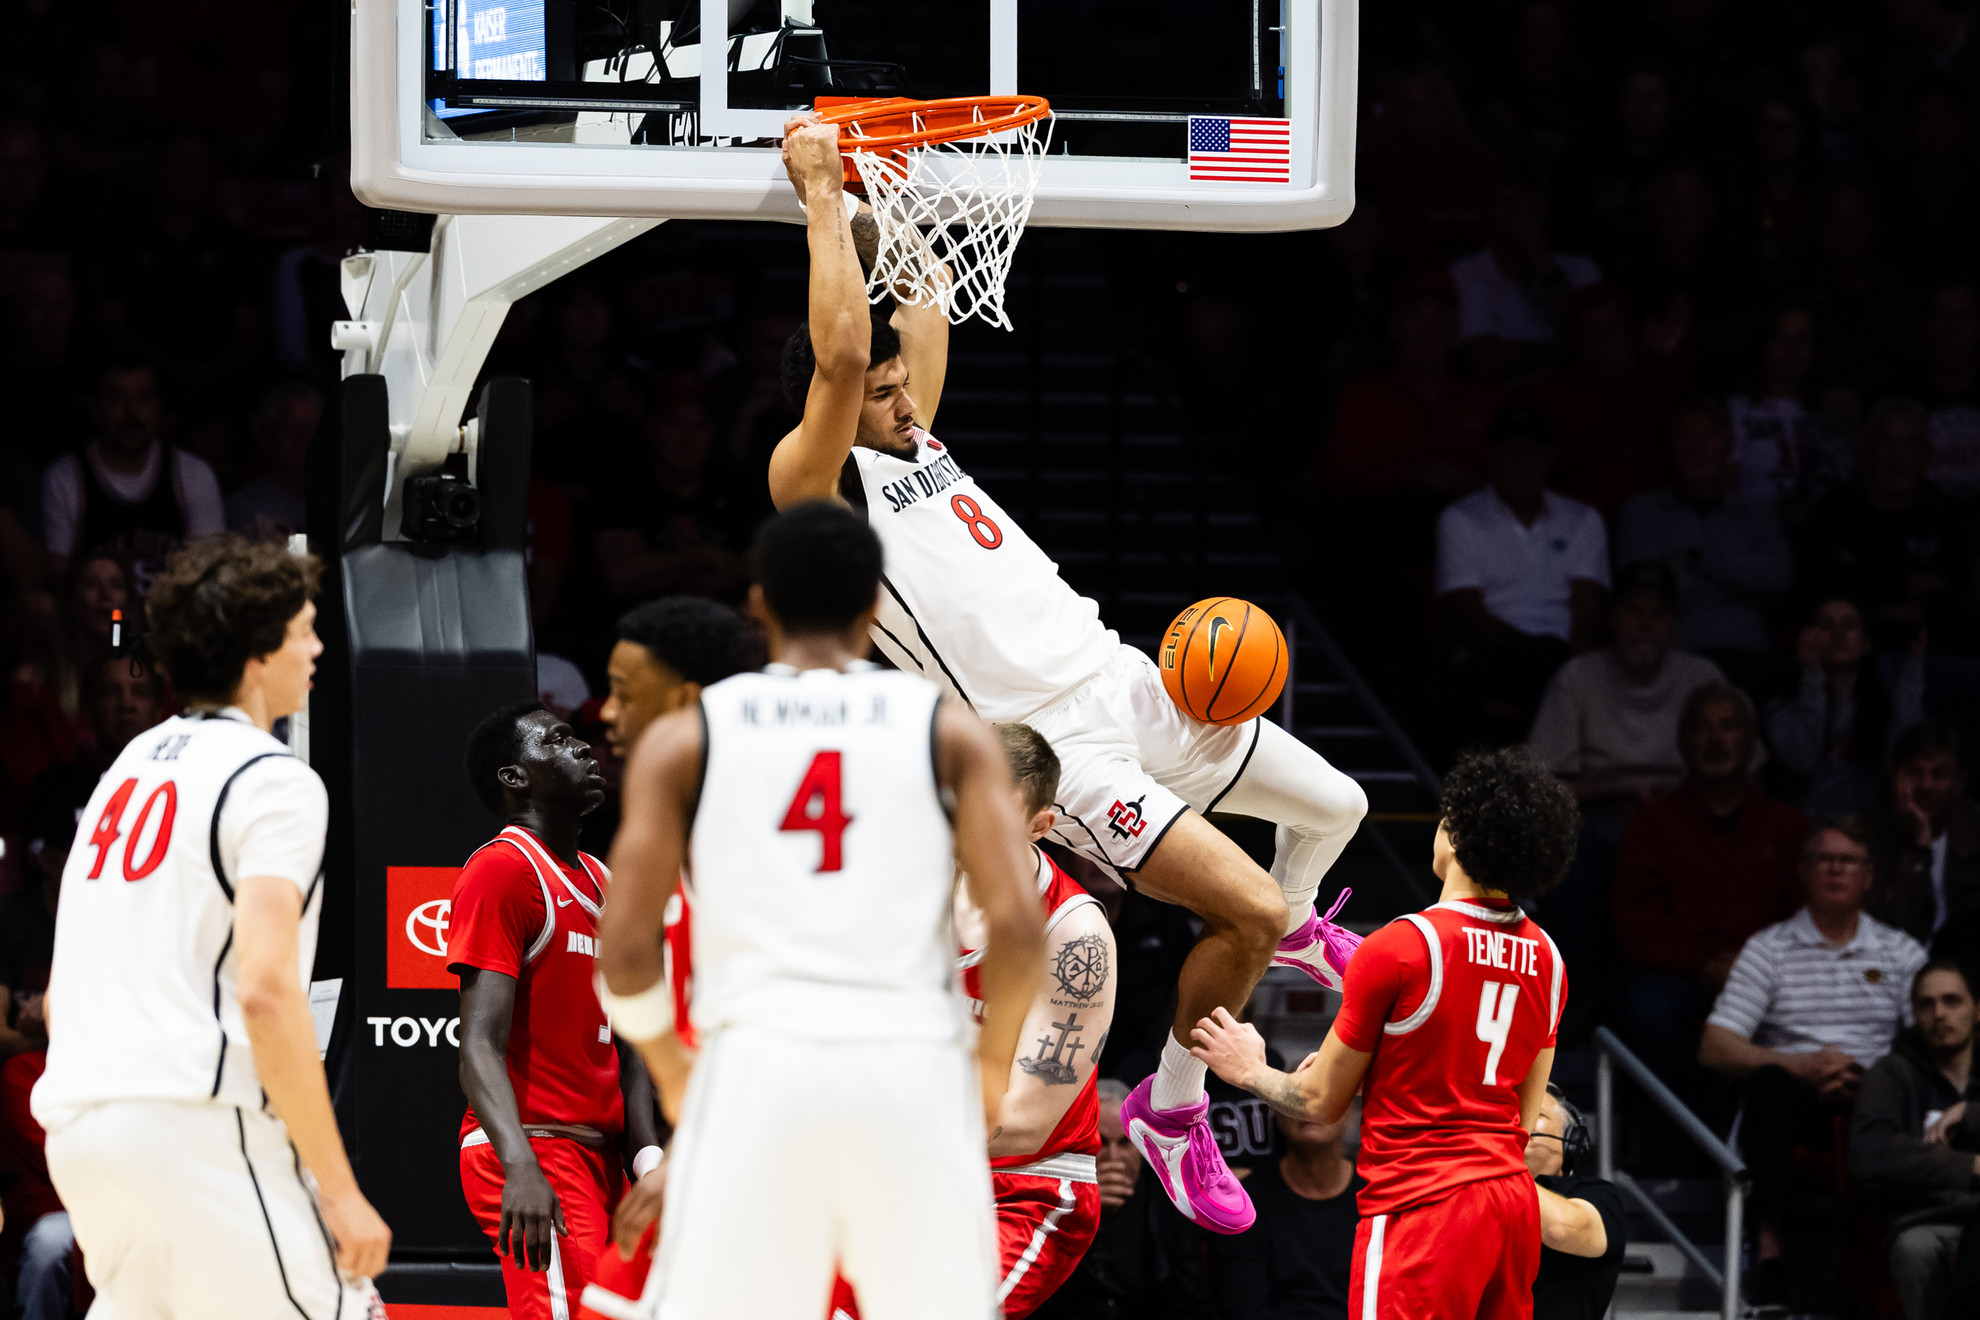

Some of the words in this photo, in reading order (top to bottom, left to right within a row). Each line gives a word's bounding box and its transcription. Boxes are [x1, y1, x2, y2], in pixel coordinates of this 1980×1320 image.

[474, 7, 506, 45] KAISER
[881, 475, 921, 513] SAN
[950, 493, 1003, 550] 8
[1163, 607, 1200, 670] ELITE
[87, 777, 177, 882] 40
[776, 750, 854, 873] 4
[566, 930, 594, 957] NEW
[1461, 926, 1539, 977] TENETTE
[1050, 998, 1088, 1009] MATTHEW
[1475, 980, 1521, 1086] 4
